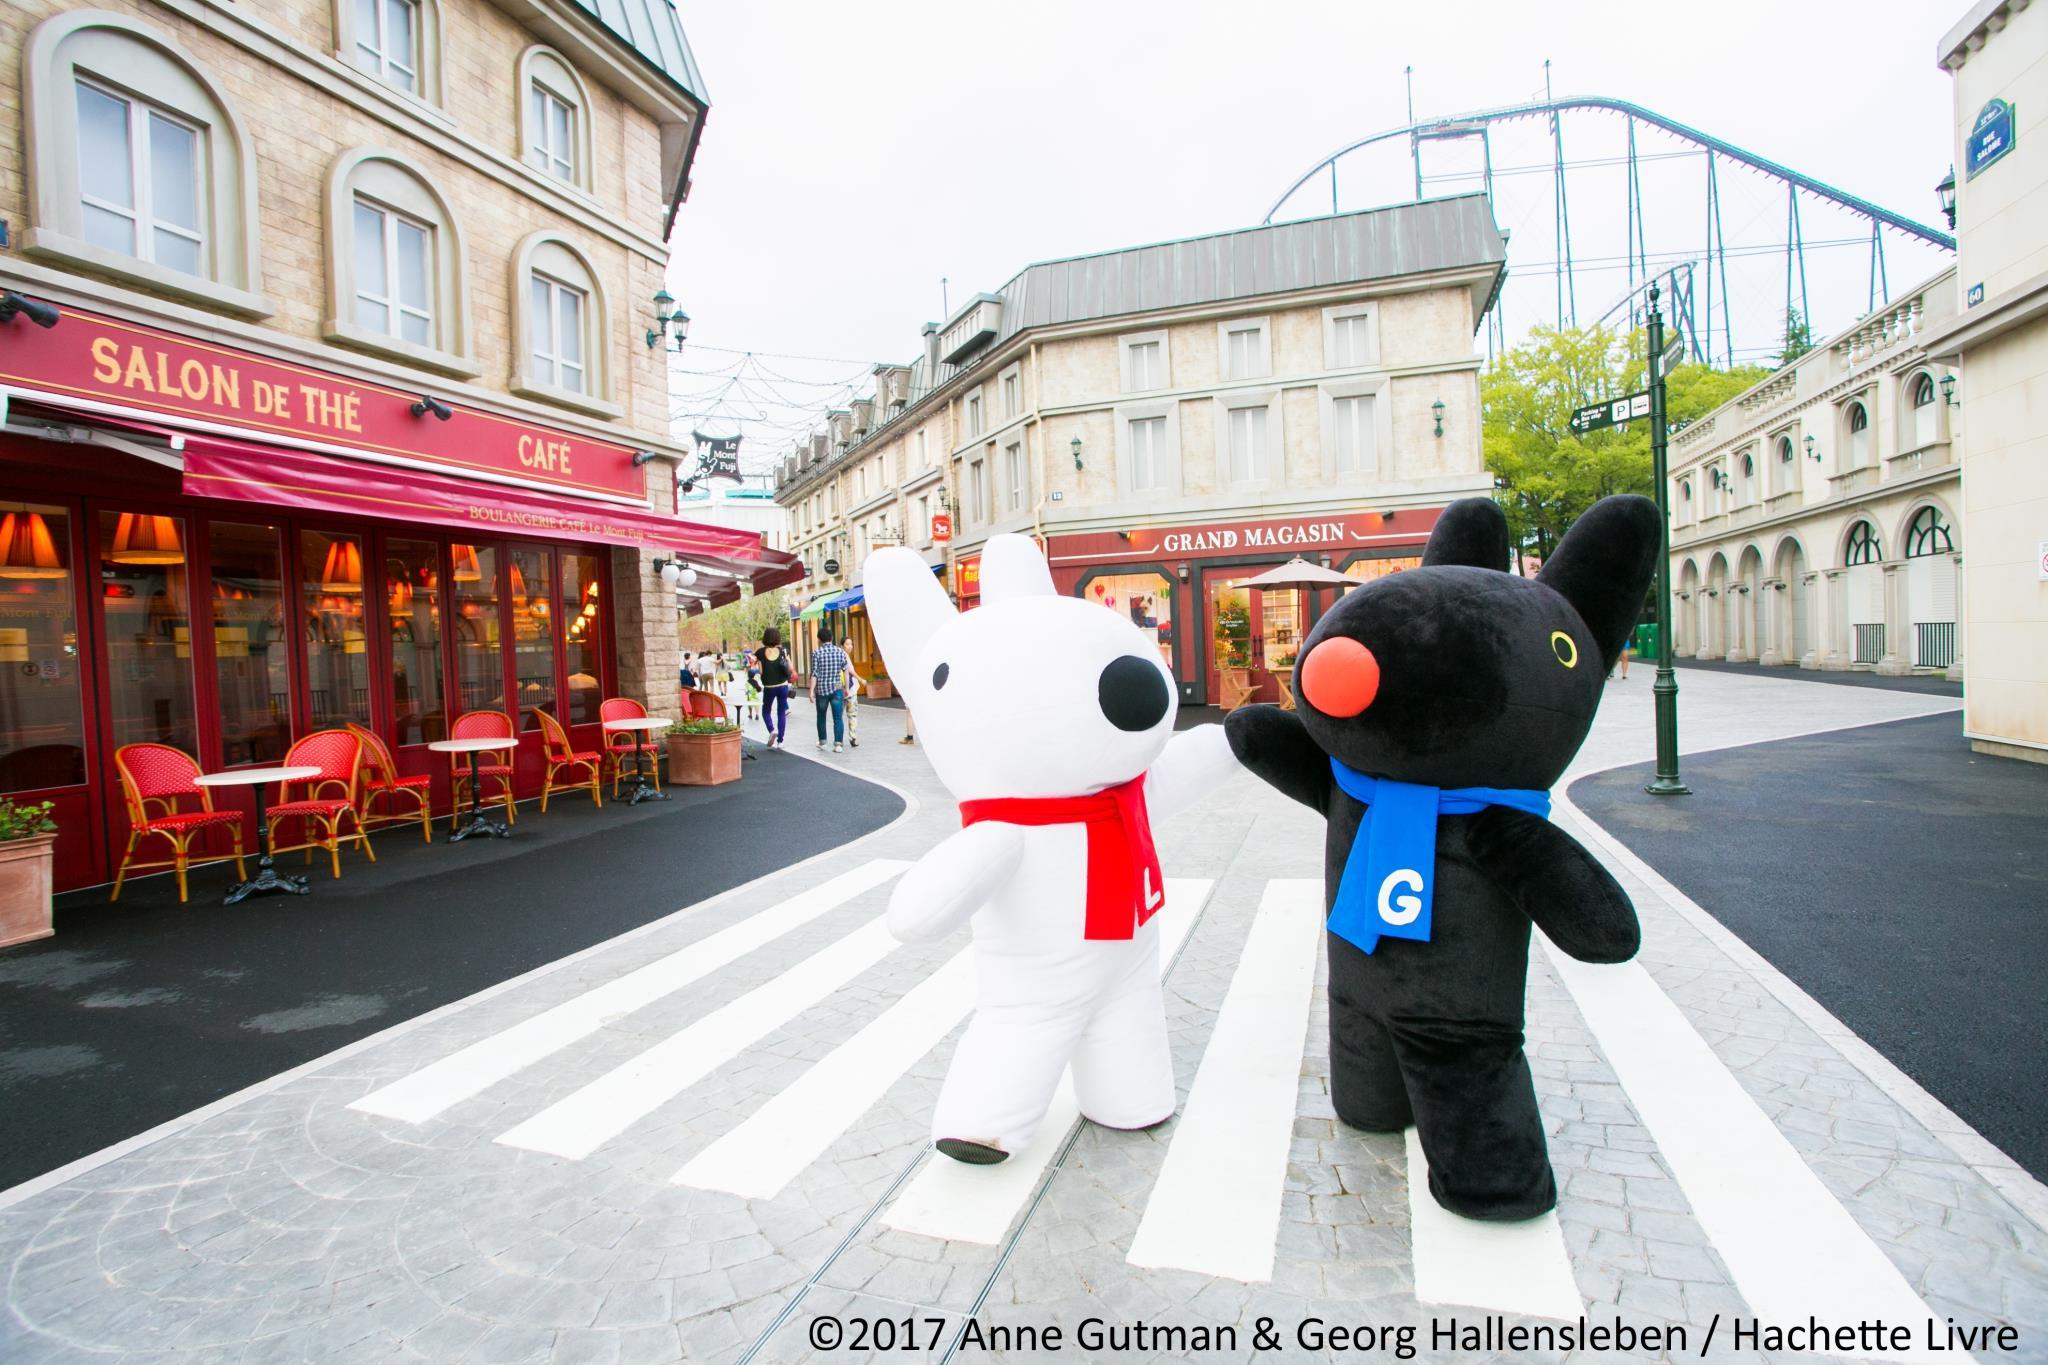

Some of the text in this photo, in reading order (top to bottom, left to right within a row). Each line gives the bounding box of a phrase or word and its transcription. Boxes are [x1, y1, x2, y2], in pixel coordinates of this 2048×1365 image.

[1969, 288, 1982, 304] 60
[91, 337, 362, 433] SALON DE THÉ
[1617, 406, 1625, 417] P
[518, 434, 572, 475] CAFÉ
[713, 450, 736, 460] Mont
[725, 440, 736, 450] Le
[719, 461, 736, 473] Fuji
[469, 505, 644, 542] BOULANGERIE CAFÉ Le Mont Fuji
[1163, 522, 1345, 552] GRAND MAGASIN
[1144, 867, 1161, 911] L
[1377, 868, 1424, 926] G
